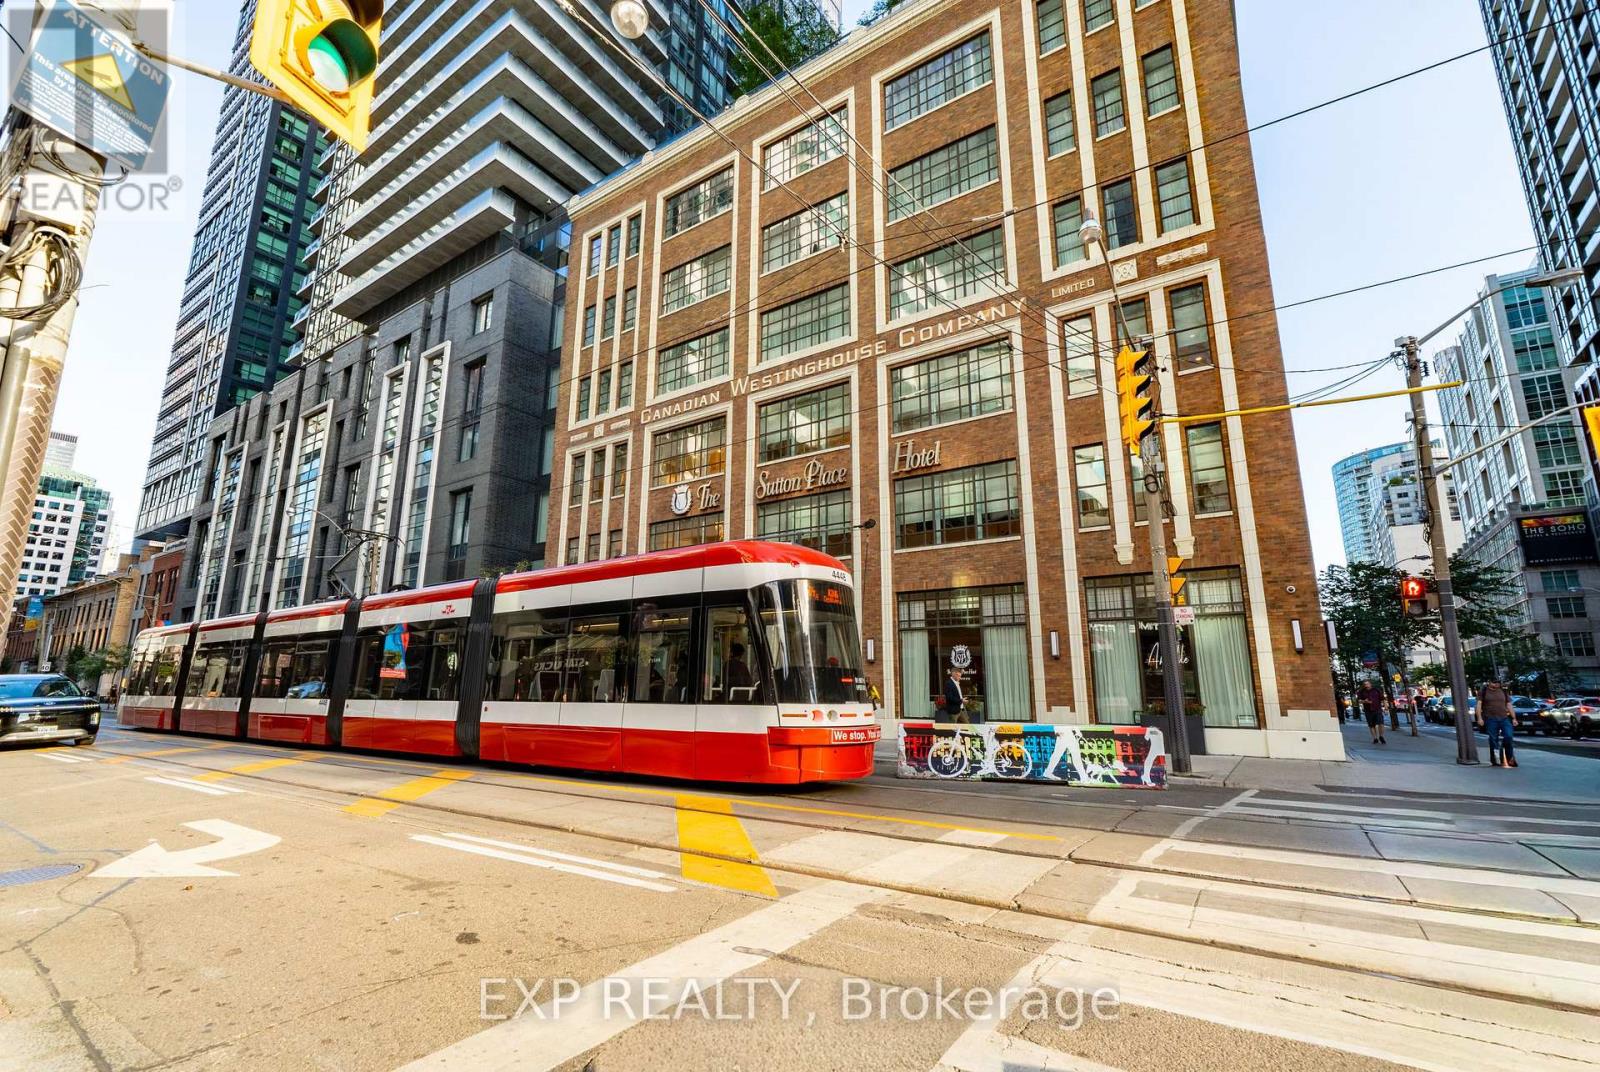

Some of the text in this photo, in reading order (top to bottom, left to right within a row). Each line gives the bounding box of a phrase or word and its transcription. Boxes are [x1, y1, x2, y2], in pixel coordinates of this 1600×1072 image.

[63, 9, 165, 86] ATTENTION
[34, 51, 55, 71] This
[54, 75, 67, 89] by
[697, 438, 942, 511] The Sutton Place Hotel
[1550, 524, 1586, 533] SOHO
[834, 730, 848, 741] We
[849, 730, 867, 742] stop.
